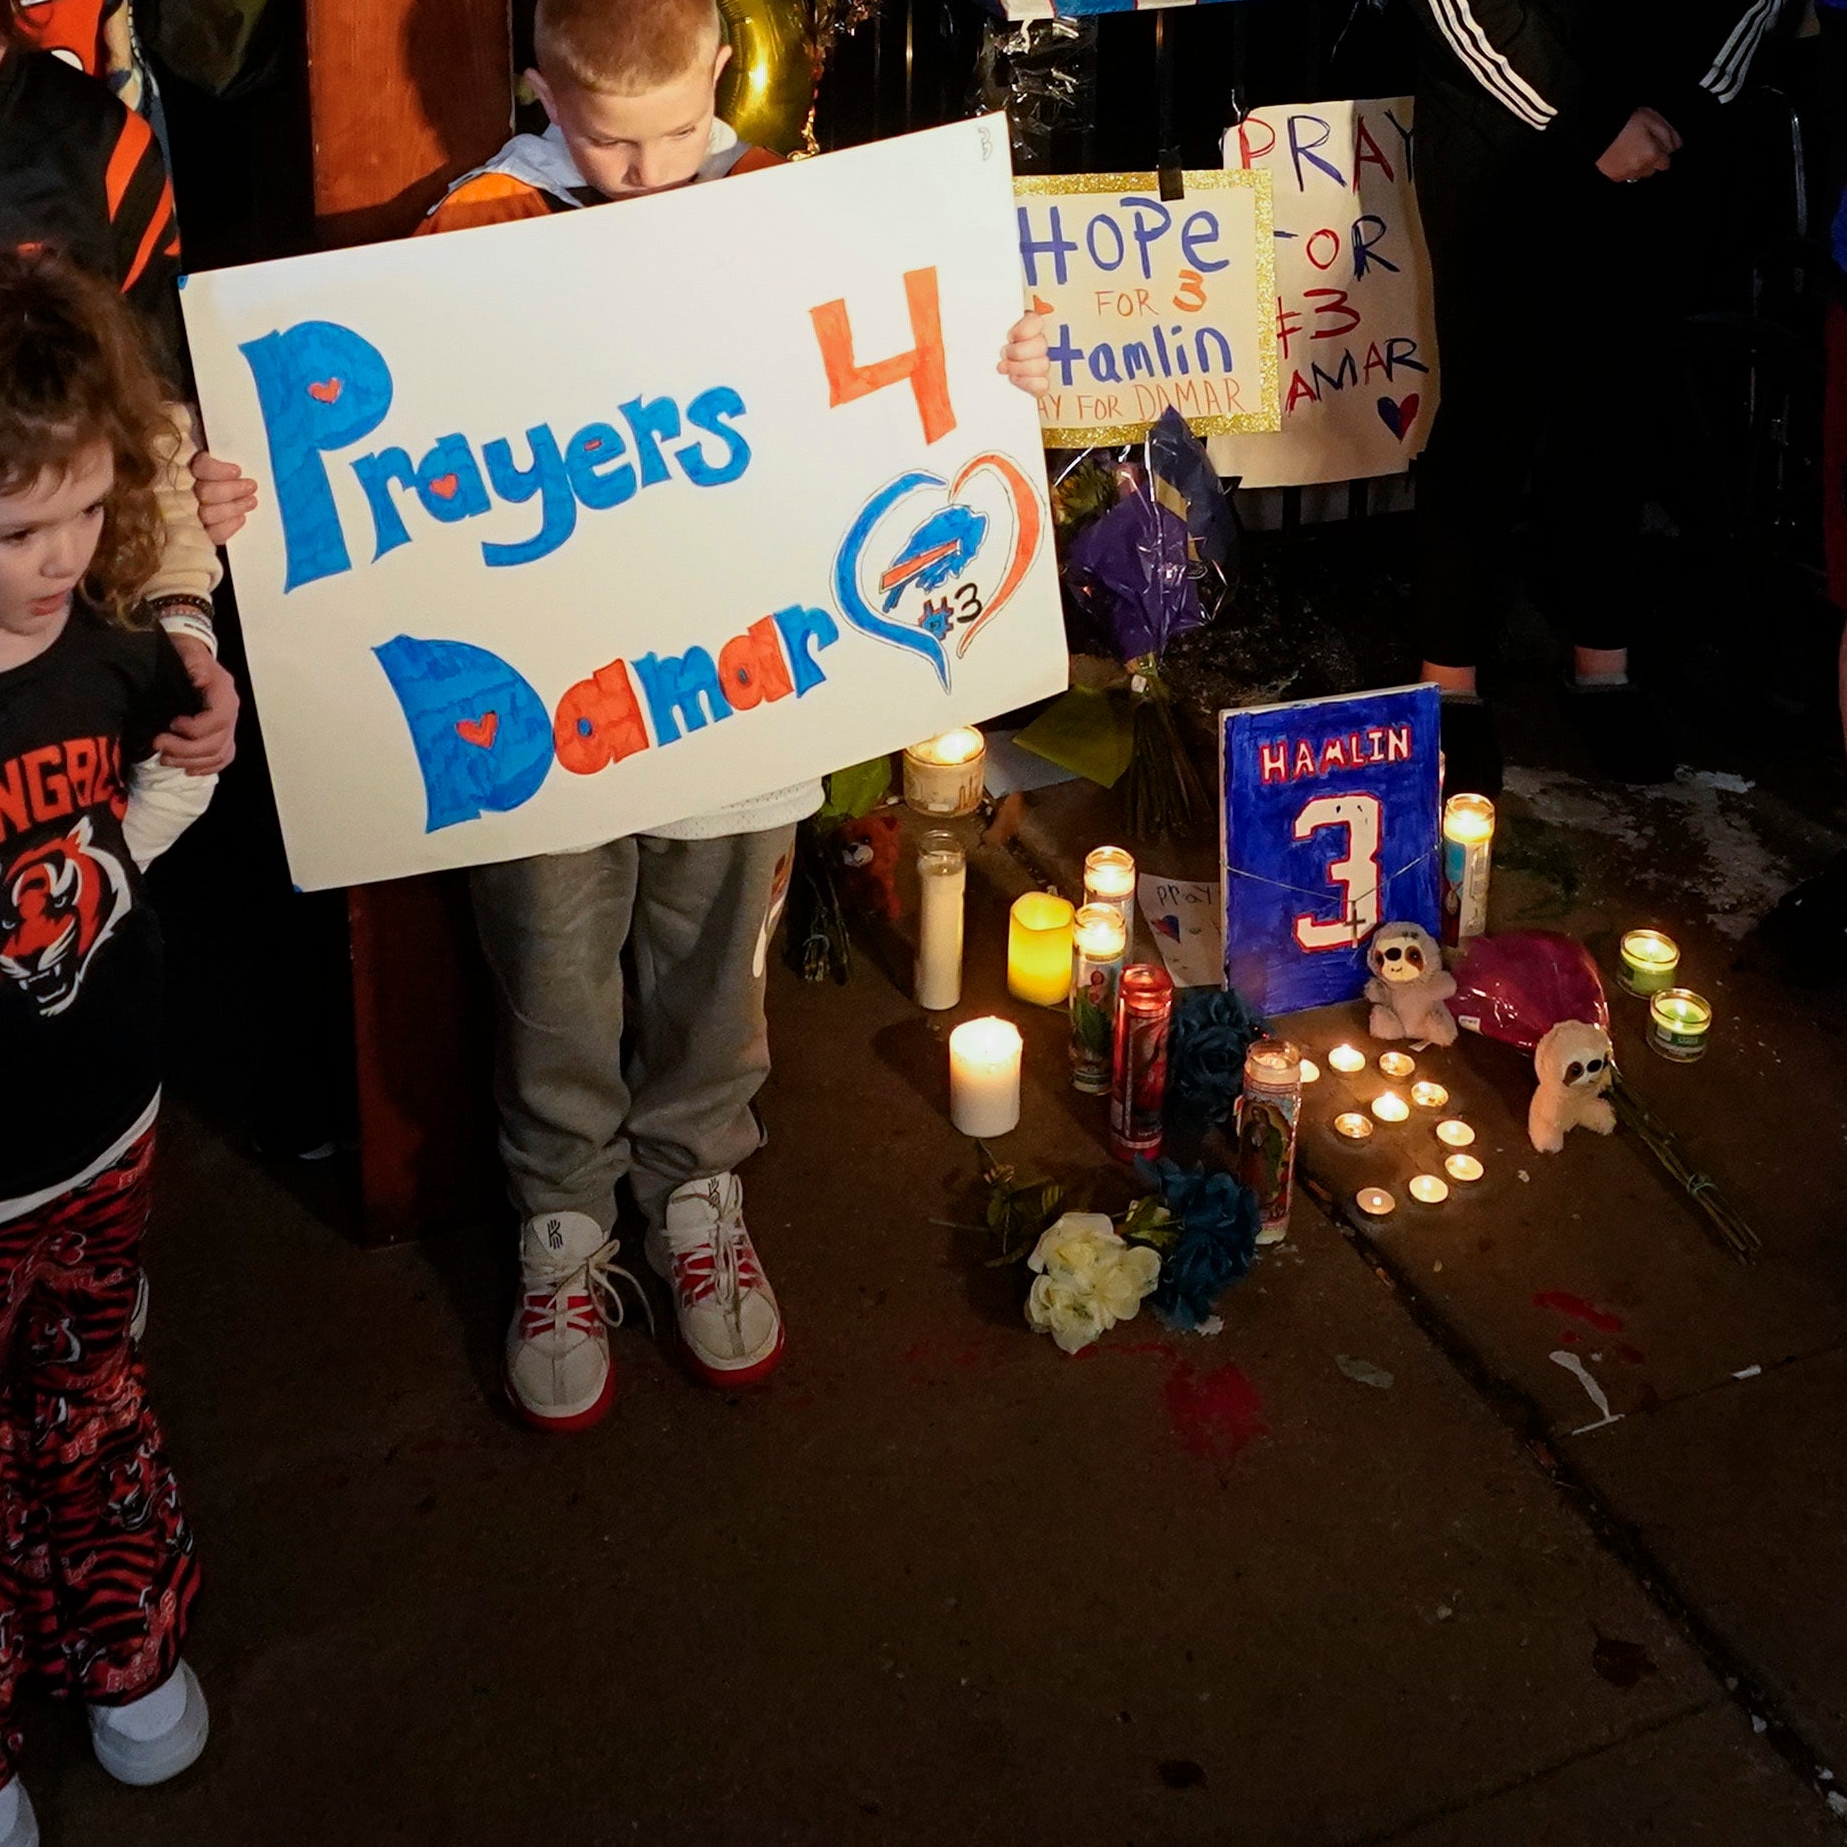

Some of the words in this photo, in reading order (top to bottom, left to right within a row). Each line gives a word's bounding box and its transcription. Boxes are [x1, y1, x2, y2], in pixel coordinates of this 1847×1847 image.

[1238, 109, 1417, 192] PRAY
[1274, 215, 1400, 281] OR
[1095, 289, 1159, 318] FOR
[1173, 270, 1208, 313] 3
[1077, 395, 1121, 421] FOR
[1135, 377, 1246, 421] DAMAR
[1284, 337, 1429, 413] AMAR
[239, 320, 752, 593] Prayers
[809, 265, 957, 445] 4
[917, 582, 983, 640] #3
[371, 604, 840, 834] Damar
[1259, 723, 1412, 785] HAMLIN
[1292, 791, 1383, 954] 3
